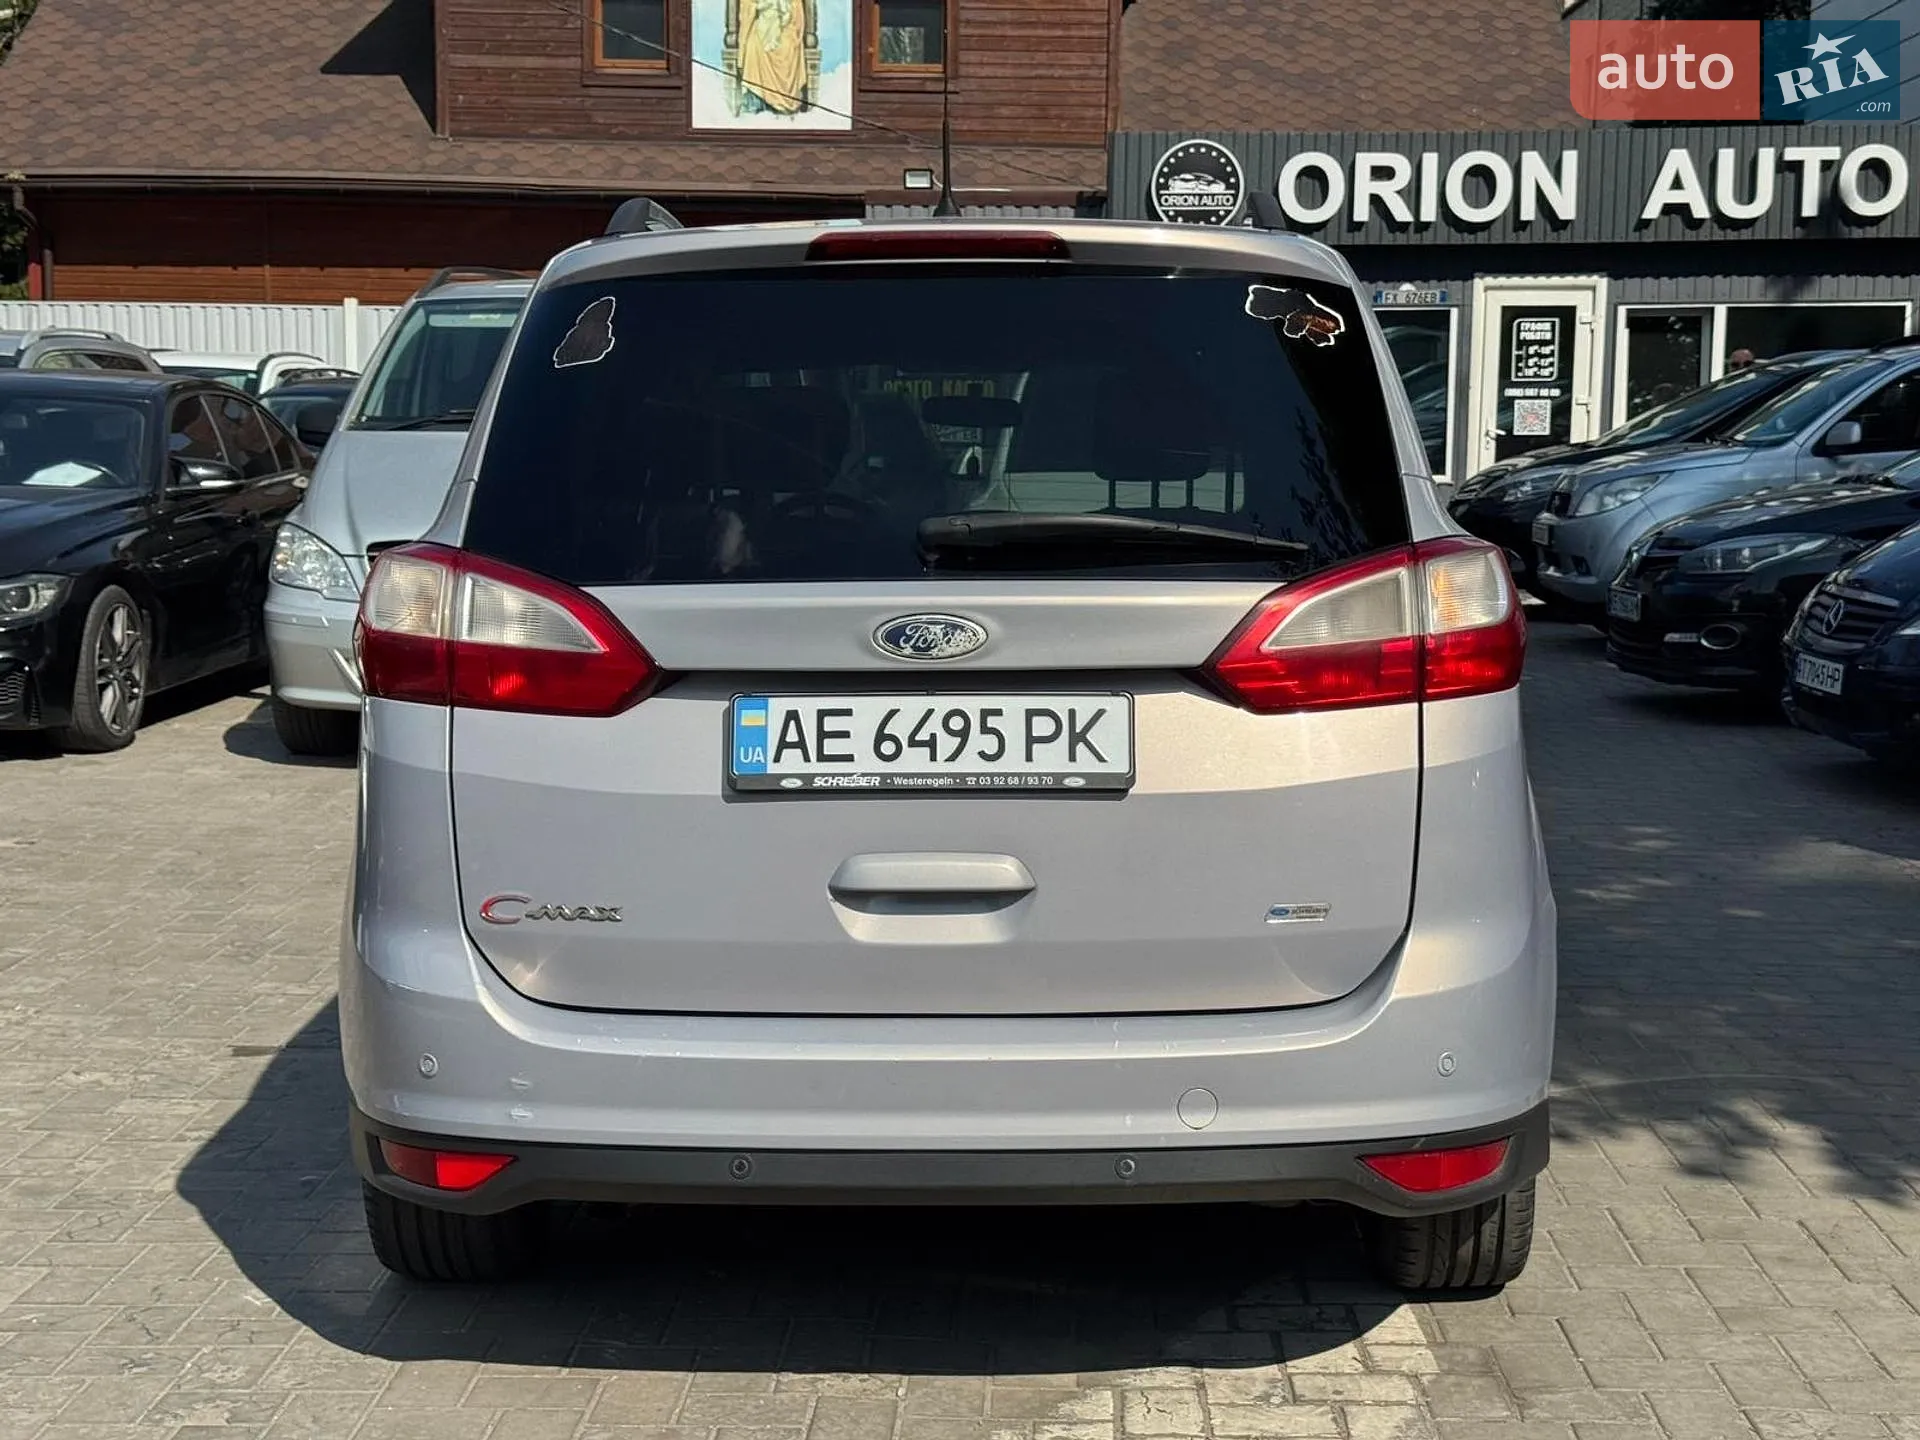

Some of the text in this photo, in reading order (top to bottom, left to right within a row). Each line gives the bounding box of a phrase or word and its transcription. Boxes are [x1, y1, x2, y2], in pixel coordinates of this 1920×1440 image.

[1278, 143, 1909, 224] ORION AUTO
[1160, 195, 1234, 206] ORION AUTO
[740, 708, 1109, 763] UA AE 6495 PK
[979, 776, 991, 785] 03
[993, 776, 1005, 785] 92
[1027, 776, 1039, 785] 93
[1042, 776, 1053, 785] 70
